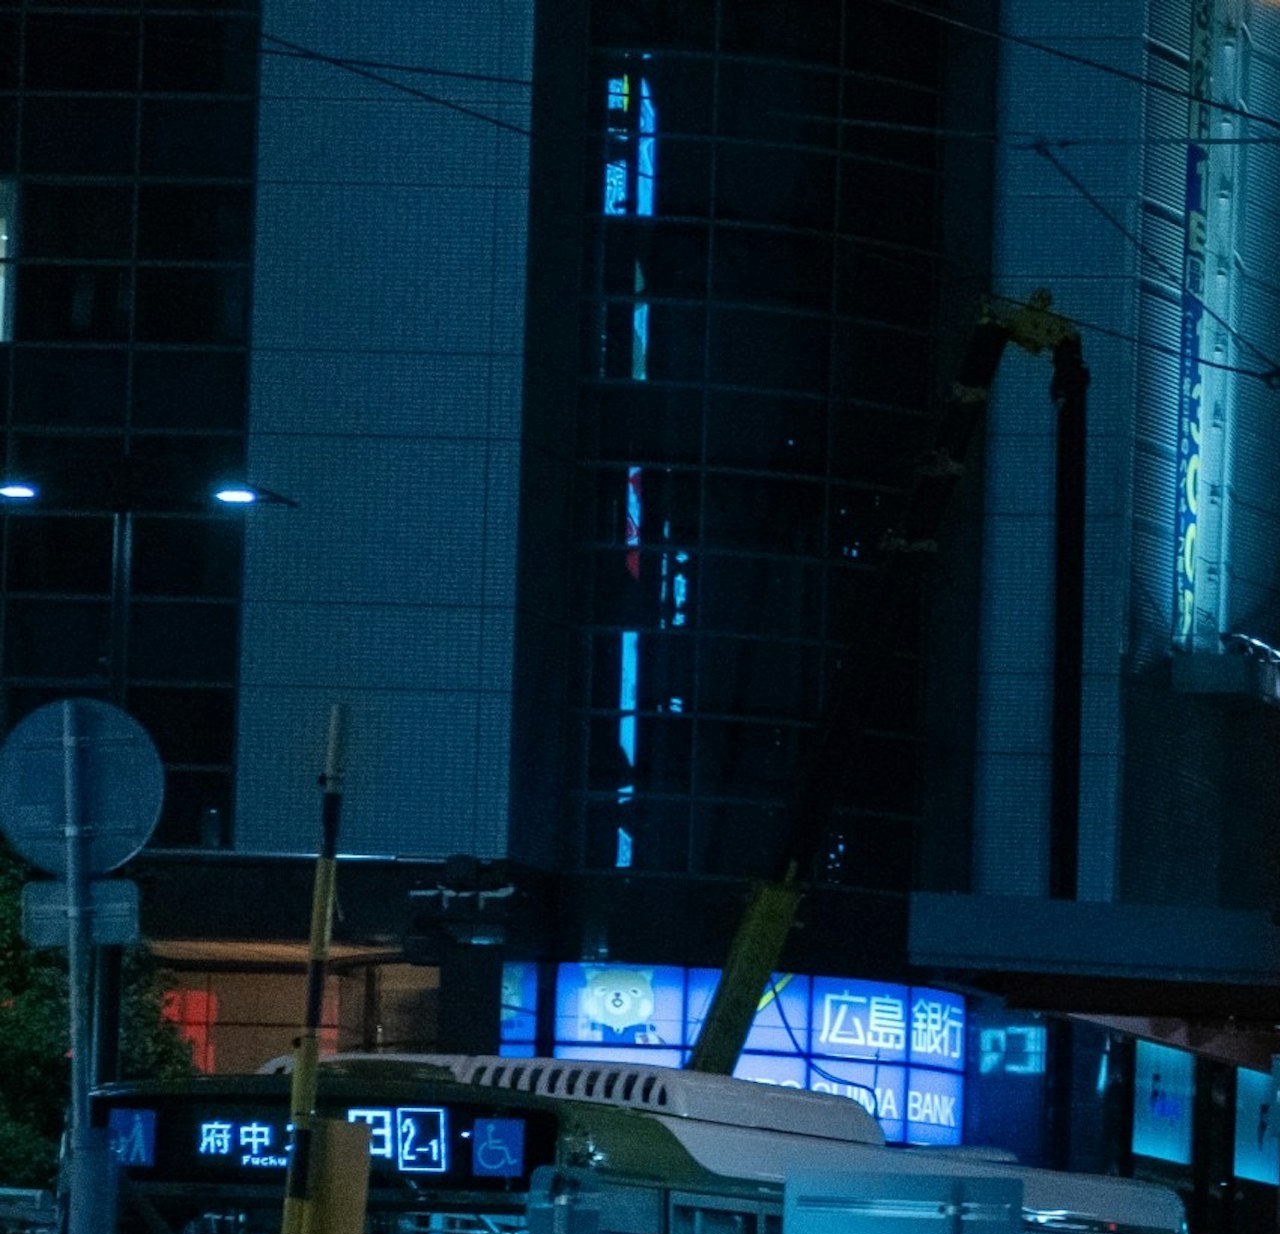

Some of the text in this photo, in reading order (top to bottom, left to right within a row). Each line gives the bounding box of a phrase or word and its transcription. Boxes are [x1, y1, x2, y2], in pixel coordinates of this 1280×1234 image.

[819, 990, 963, 1058] 広島銀行
[907, 1090, 956, 1127] BANK
[402, 1117, 440, 1161] 2-1
